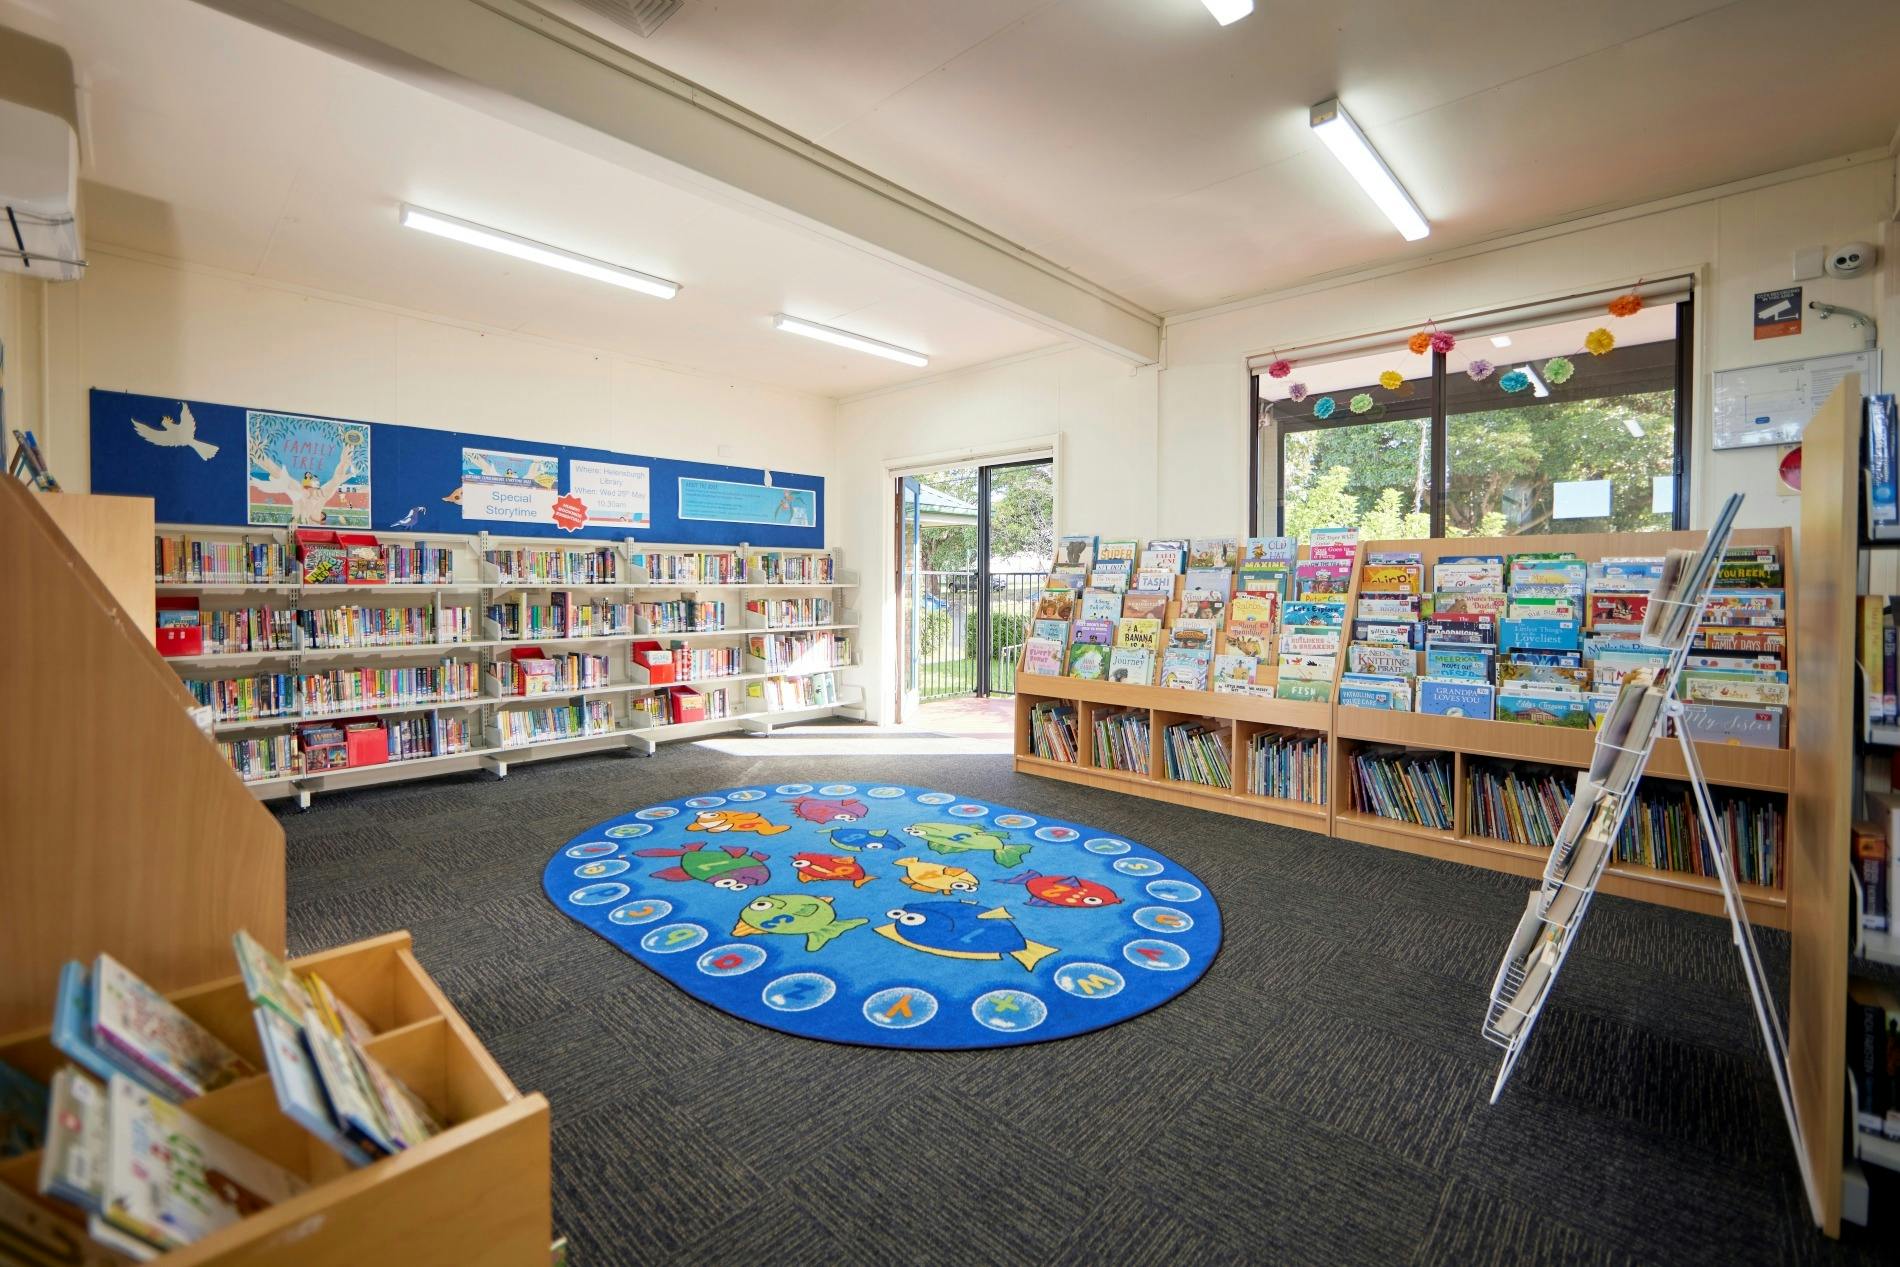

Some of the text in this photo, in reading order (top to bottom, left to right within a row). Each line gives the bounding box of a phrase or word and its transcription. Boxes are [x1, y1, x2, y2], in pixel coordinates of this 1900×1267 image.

[283, 440, 337, 456] FAMILY
[291, 456, 325, 471] TREE
[600, 478, 623, 487] Library
[492, 491, 532, 503] Special
[600, 489, 616, 497] Wed
[486, 505, 537, 518] Storytime
[1268, 540, 1287, 550] OLD
[1270, 552, 1285, 560] HAT
[1718, 568, 1771, 578] YOU REEK!
[1142, 577, 1170, 587] TASHI
[1293, 604, 1311, 612] Let's
[1540, 626, 1563, 634] Things
[1125, 633, 1153, 643] BANANA
[1515, 633, 1561, 643] Loveliest
[1712, 639, 1780, 652] FAMILY DAYS OUT
[1369, 649, 1386, 657] NED
[1113, 655, 1145, 666] Journey
[1358, 653, 1410, 667] KNITTING
[1435, 655, 1479, 663] MEERKAT
[1377, 665, 1405, 673] PIRATE
[1291, 686, 1317, 696] FISH
[1343, 690, 1376, 699] PATROLLING
[1436, 688, 1478, 697] GRANDPA
[1434, 694, 1480, 704] LOVES YOU
[1687, 711, 1772, 731] My Sister
[1041, 884, 1072, 899] 2
[760, 914, 795, 929] 3
